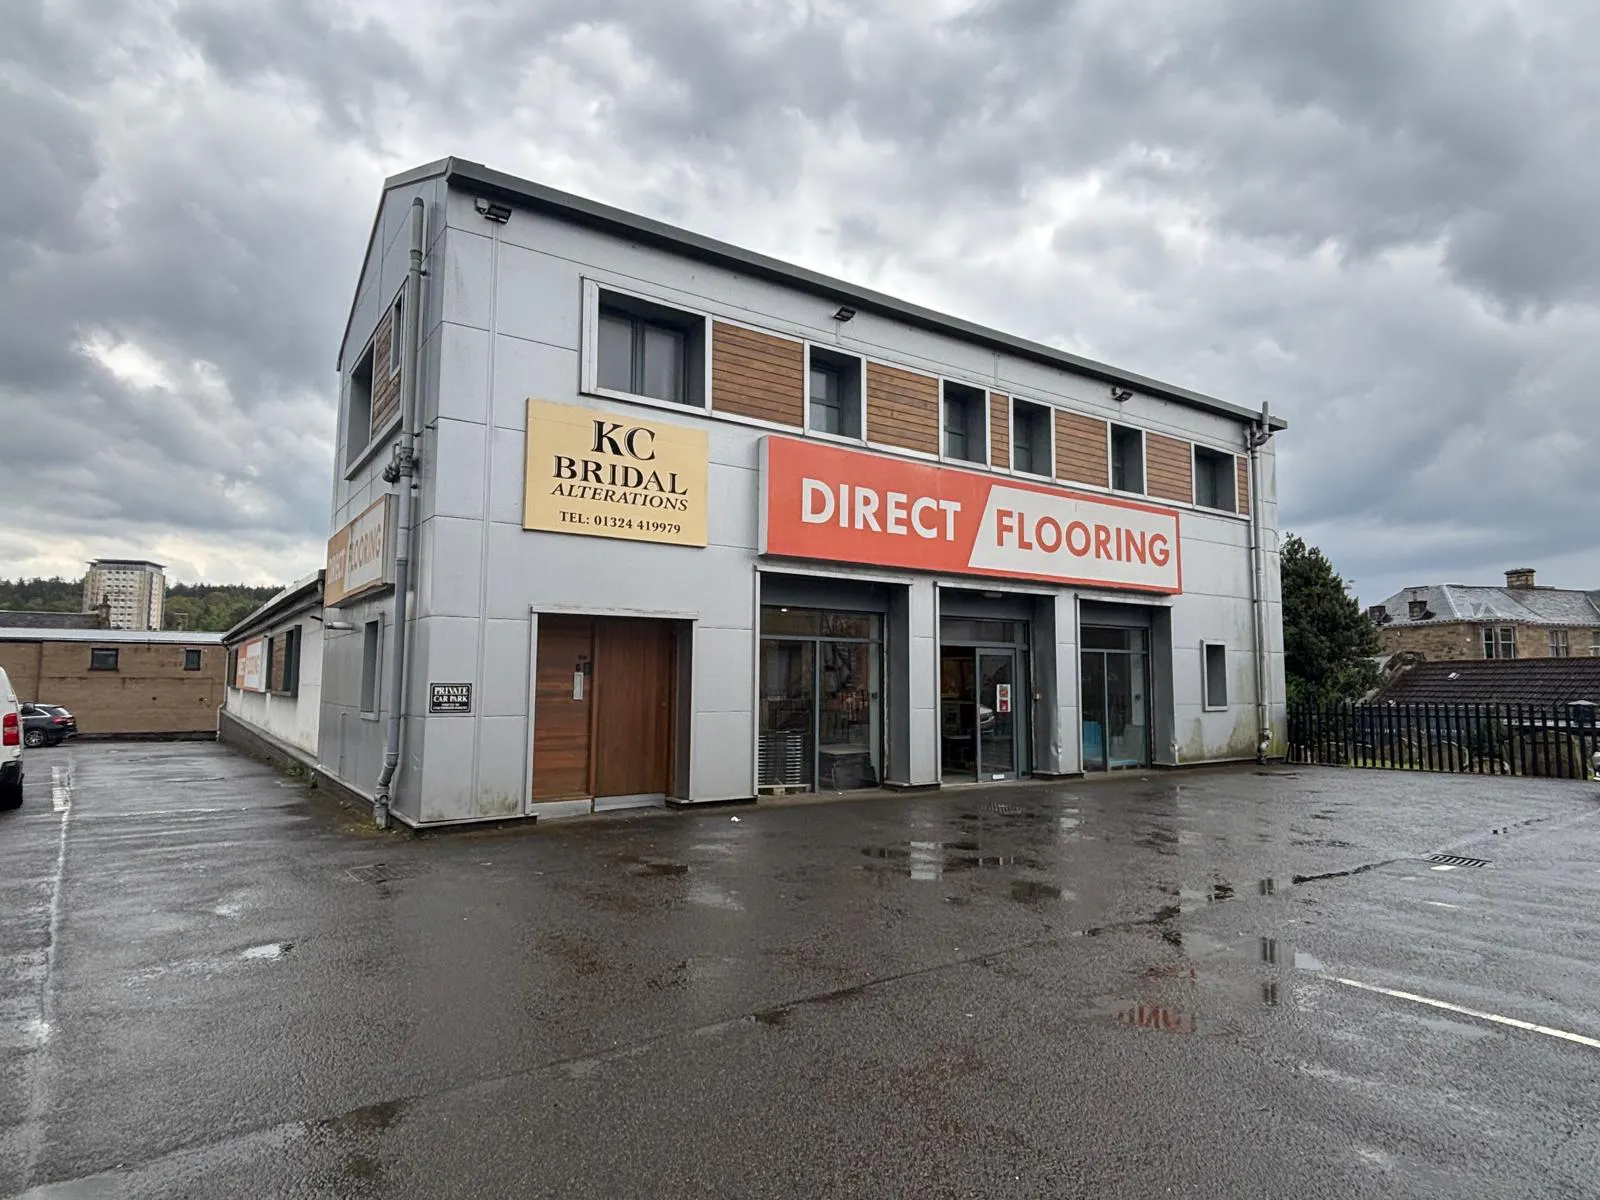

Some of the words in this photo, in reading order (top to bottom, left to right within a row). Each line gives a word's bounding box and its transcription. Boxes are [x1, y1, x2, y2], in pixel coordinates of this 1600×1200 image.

[590, 419, 656, 461] KC
[553, 455, 688, 496] BRIDAL
[550, 482, 688, 512] ALTERATIONS
[559, 511, 590, 525] TEL:
[594, 514, 633, 529] 01324
[636, 520, 681, 534] 419979
[801, 477, 961, 541] DIRECT
[996, 508, 1170, 568] FLOORING
[433, 695, 448, 703] CAR
[434, 686, 468, 695] PRIVATE
